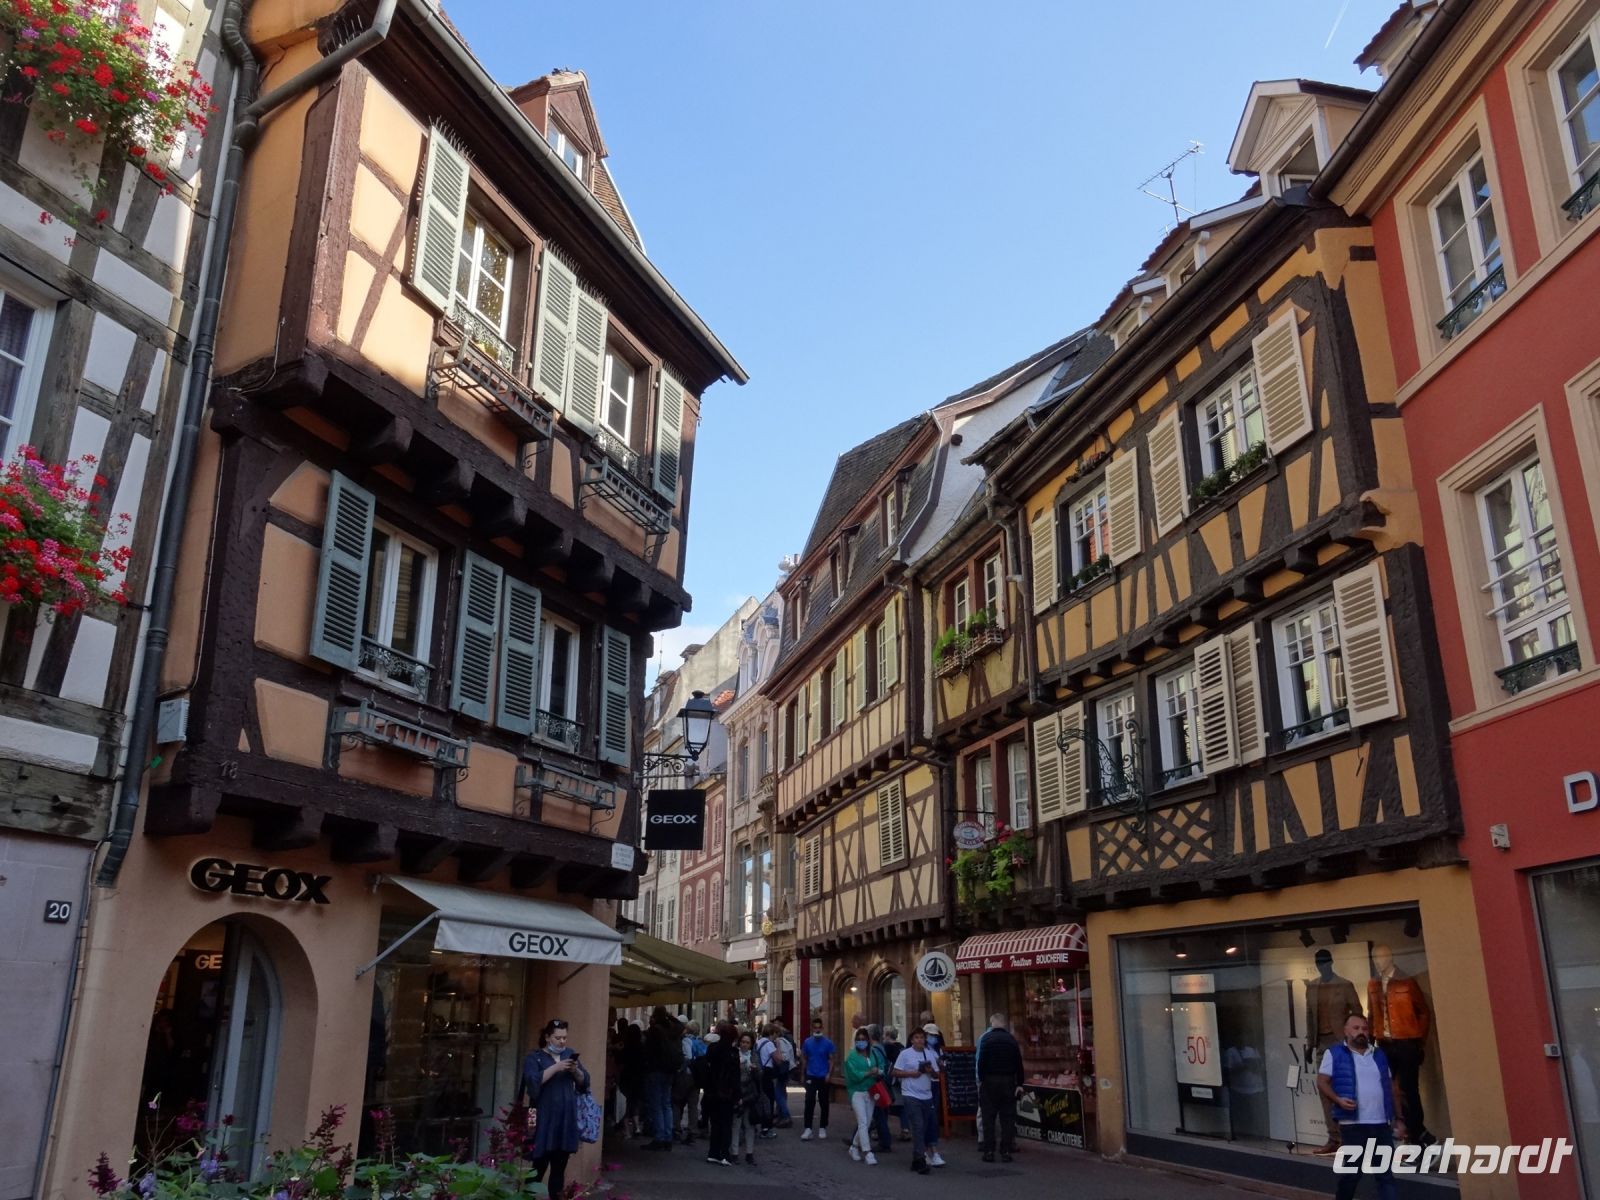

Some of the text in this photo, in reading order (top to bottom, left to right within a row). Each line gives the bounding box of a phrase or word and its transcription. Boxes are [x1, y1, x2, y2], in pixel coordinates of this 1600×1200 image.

[220, 760, 239, 779] 18
[650, 814, 698, 824] GEOX
[190, 857, 332, 904] GEOX
[48, 902, 70, 919] 20
[509, 932, 569, 957] GEOX
[1035, 952, 1069, 965] BOUCHERIE
[1047, 1130, 1083, 1148] CHARCUTERIE
